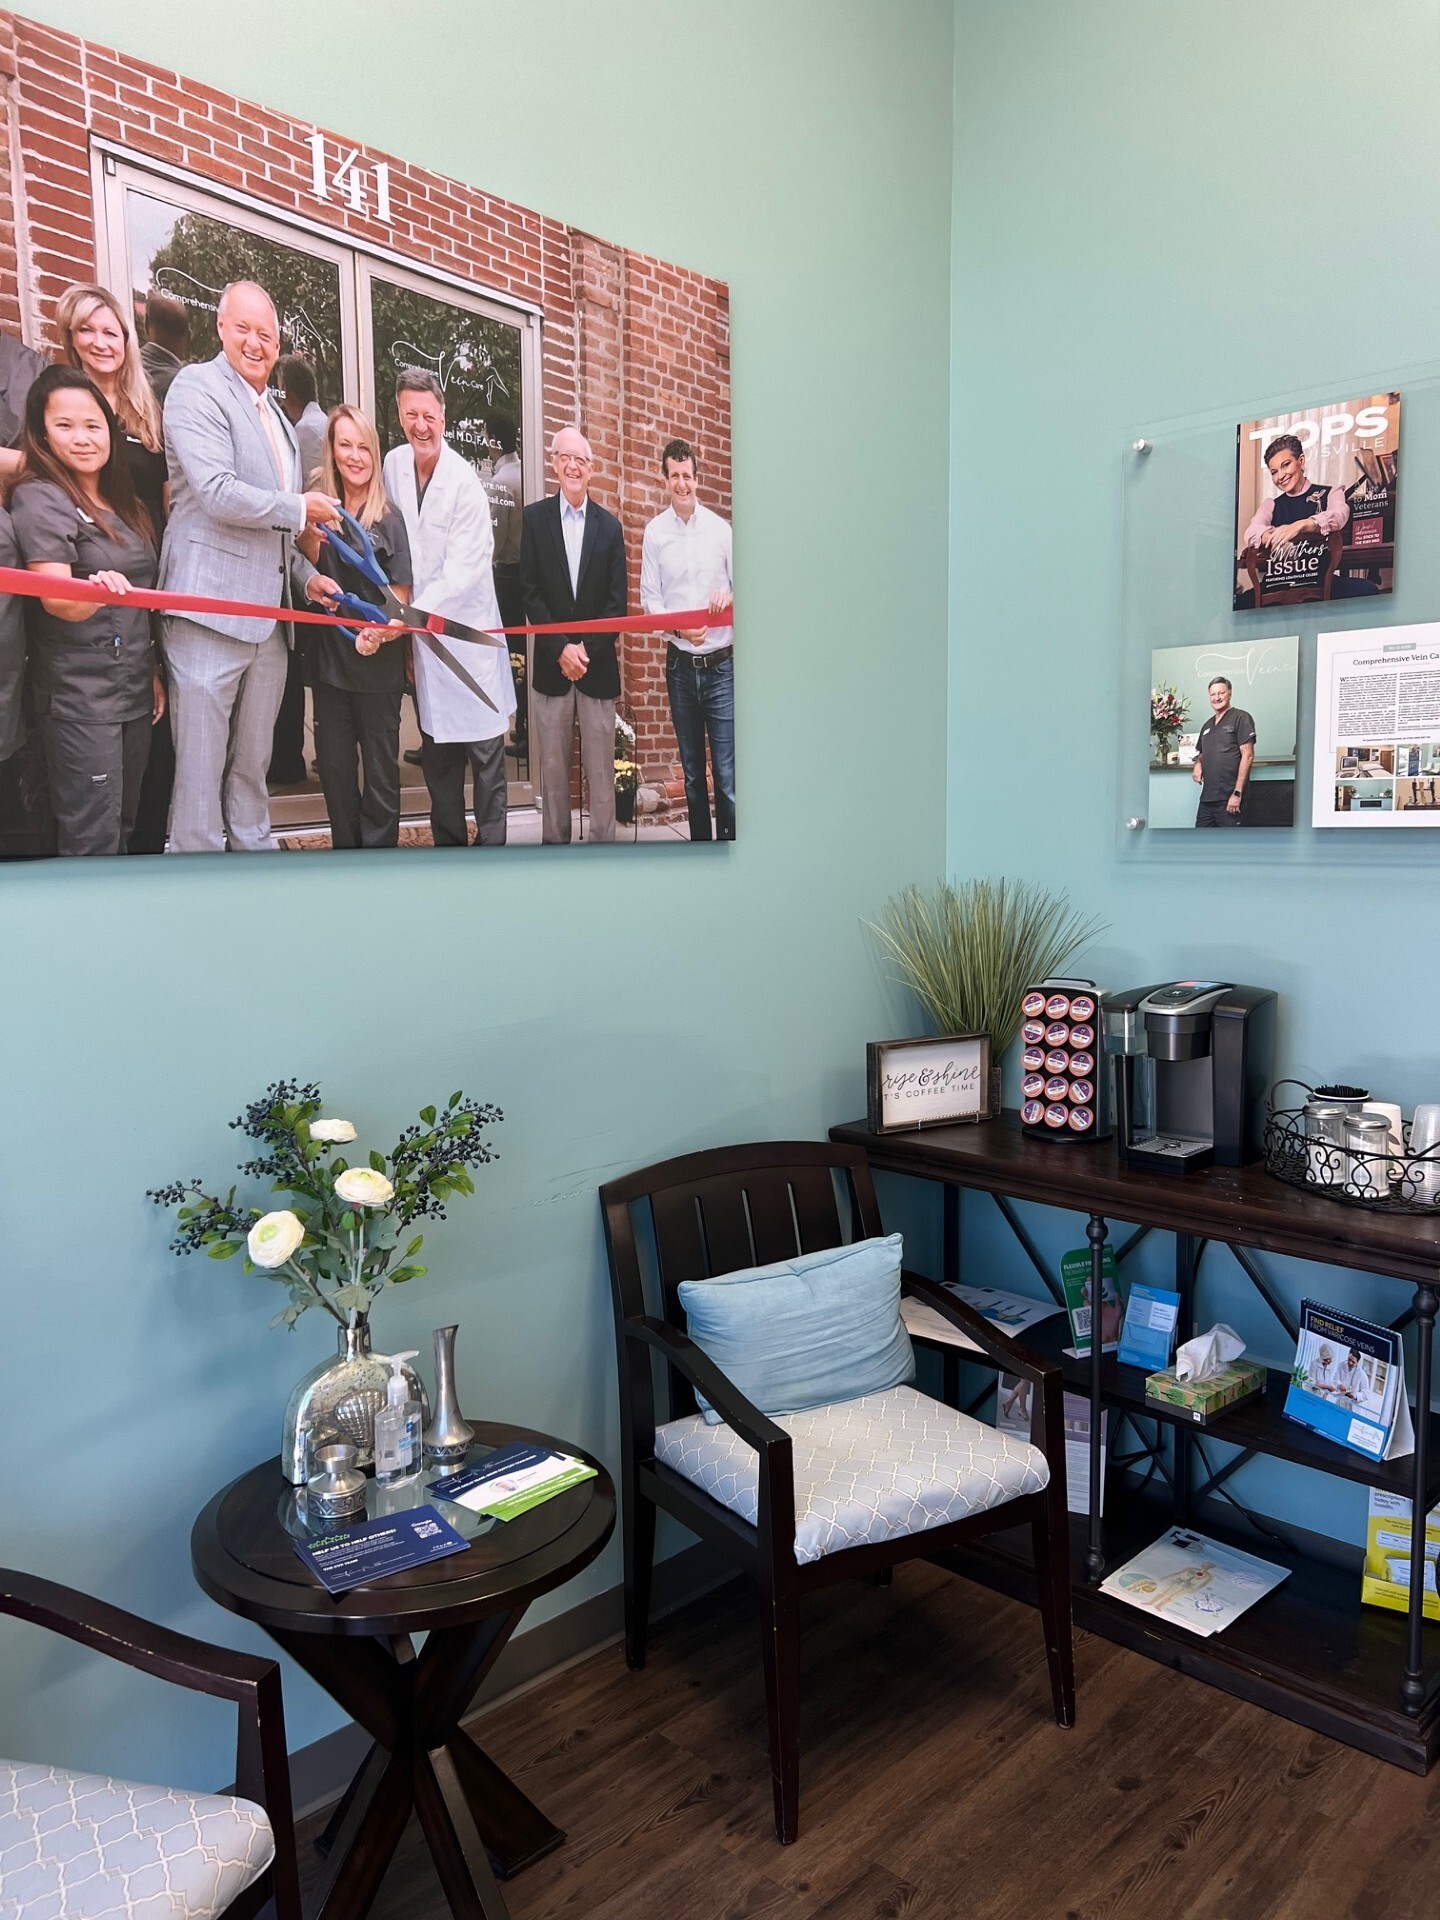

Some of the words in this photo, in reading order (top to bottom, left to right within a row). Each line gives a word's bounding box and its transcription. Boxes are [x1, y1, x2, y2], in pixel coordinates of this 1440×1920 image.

[303, 133, 396, 226] 141
[160, 288, 218, 313] Comprehensiv
[443, 429, 455, 440] uel
[1249, 406, 1389, 468] TOPS
[1305, 437, 1385, 461] UISVILLE
[481, 481, 507, 492] are.net
[487, 496, 515, 507] ail.com
[1353, 496, 1362, 504] to
[1364, 492, 1387, 502] Mom
[1353, 500, 1389, 511] Veterans
[1266, 557, 1319, 577] Issue
[1352, 655, 1410, 666] Comprehensive
[1411, 653, 1428, 661] Vein
[882, 1072, 918, 1091] rise
[932, 1061, 980, 1086] shine
[883, 1092, 900, 1101] T'S
[906, 1086, 945, 1098] COFFEE
[951, 1083, 975, 1092] TIME
[1310, 1315, 1325, 1327] FIND
[1324, 1319, 1345, 1334] RELIEF
[1310, 1323, 1328, 1335] FROM
[1327, 1328, 1357, 1346] VARICOSE
[1356, 1341, 1376, 1354] VEINS
[312, 1548, 329, 1556] HELP
[351, 1536, 367, 1546] HELP
